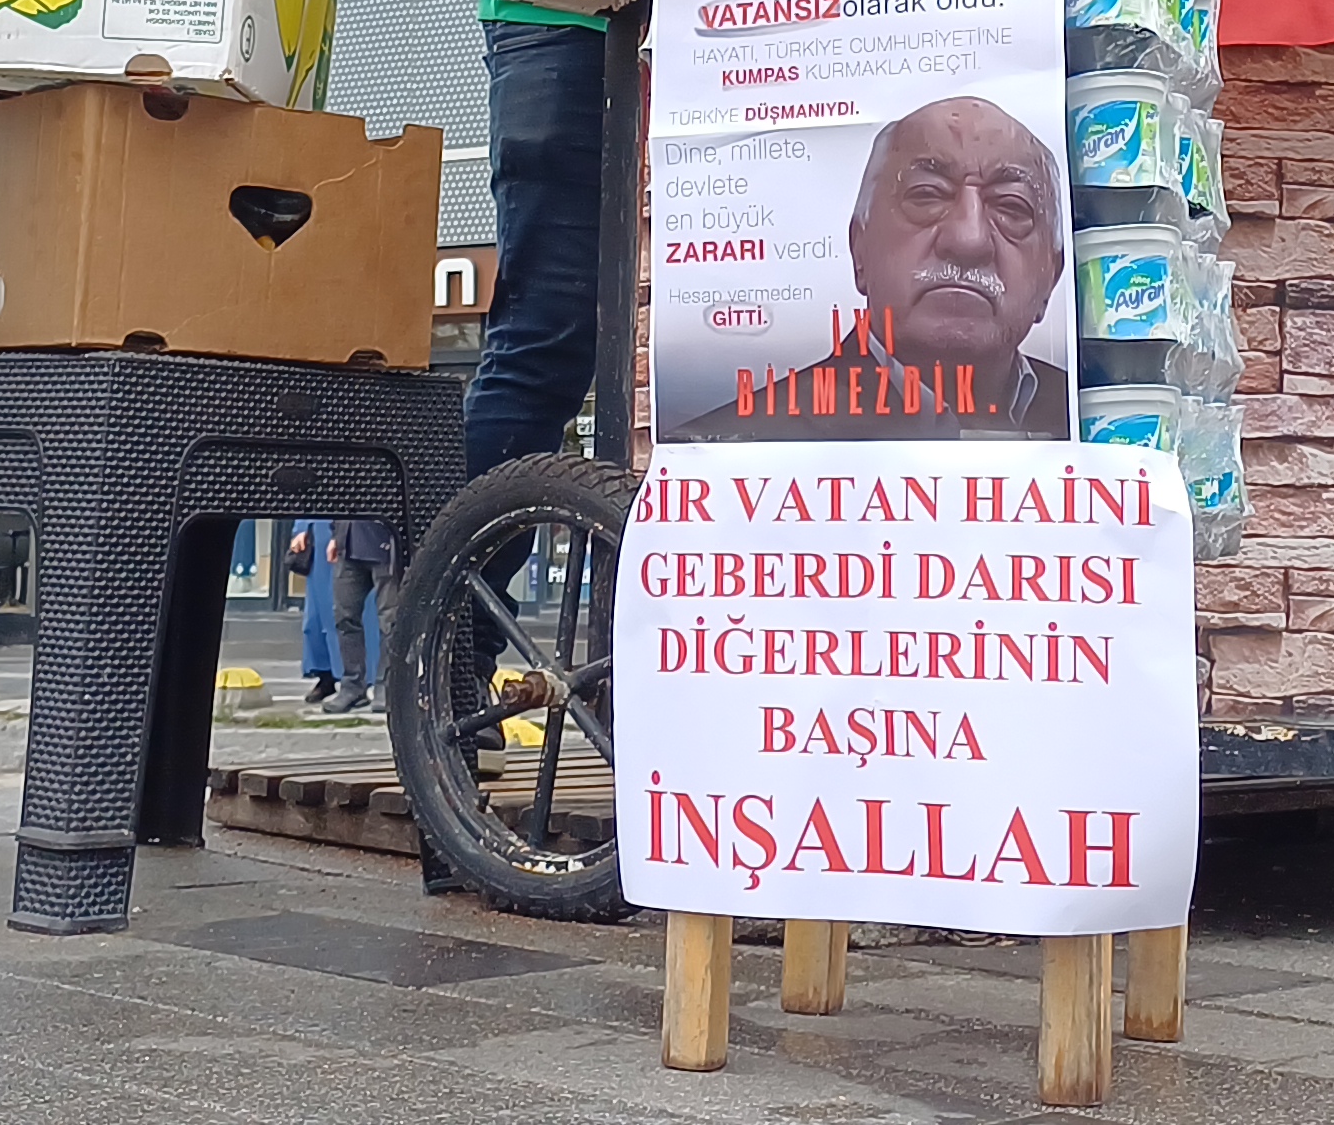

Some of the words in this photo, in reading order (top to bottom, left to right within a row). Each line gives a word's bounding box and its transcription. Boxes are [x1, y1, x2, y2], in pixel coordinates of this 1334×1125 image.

[692, 46, 759, 66] HAYATI,
[766, 37, 843, 60] TÜRKİYE
[721, 65, 801, 87] KUMPAS
[804, 57, 913, 81] KURMAKLA
[917, 51, 982, 77] GEÇTİ.
[669, 106, 740, 127] TÜRKİYE
[744, 99, 861, 126] DÜŞMANIYDI.
[665, 142, 723, 166] Dine,
[731, 137, 812, 162] millete,
[665, 174, 749, 199] devlete
[665, 213, 694, 232] en
[701, 204, 776, 234] büyük
[665, 238, 766, 265] ZARARI
[772, 235, 840, 261] verdi.
[668, 286, 723, 306] Hesap
[728, 283, 814, 304] vermeden
[1114, 281, 1166, 315] Ayran
[711, 306, 770, 328] GİTTİ.
[735, 359, 998, 419] BİLMEZDİK.
[634, 466, 716, 523] BİR
[729, 475, 944, 523] VATAN
[960, 464, 1157, 527] HAİNİ
[640, 539, 898, 600] GEBERDİ
[912, 552, 1143, 606] DARISI
[656, 613, 1114, 685] DİĞERLERİNİN
[758, 705, 988, 769] BAŞINA
[644, 769, 1142, 891] İNŞALLAH
